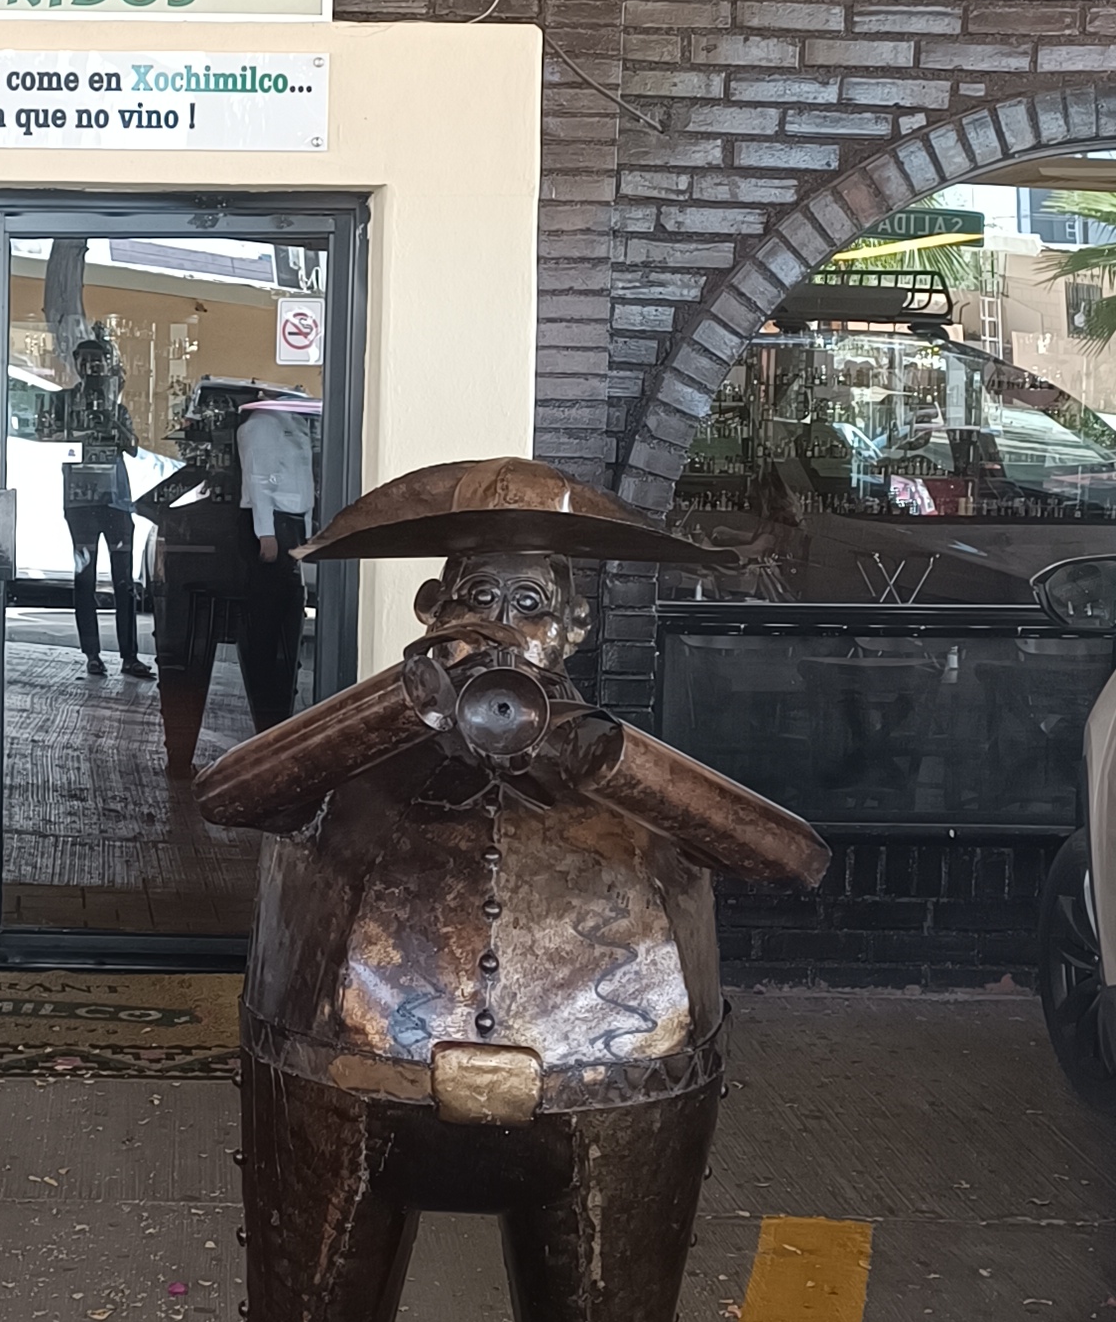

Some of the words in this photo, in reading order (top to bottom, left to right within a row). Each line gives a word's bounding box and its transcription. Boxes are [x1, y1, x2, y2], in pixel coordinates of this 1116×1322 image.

[6, 71, 79, 92] come
[88, 71, 123, 92] en
[131, 64, 312, 94] Xochimilco...
[15, 107, 68, 136] que
[75, 108, 110, 129] no
[118, 102, 180, 129] vino
